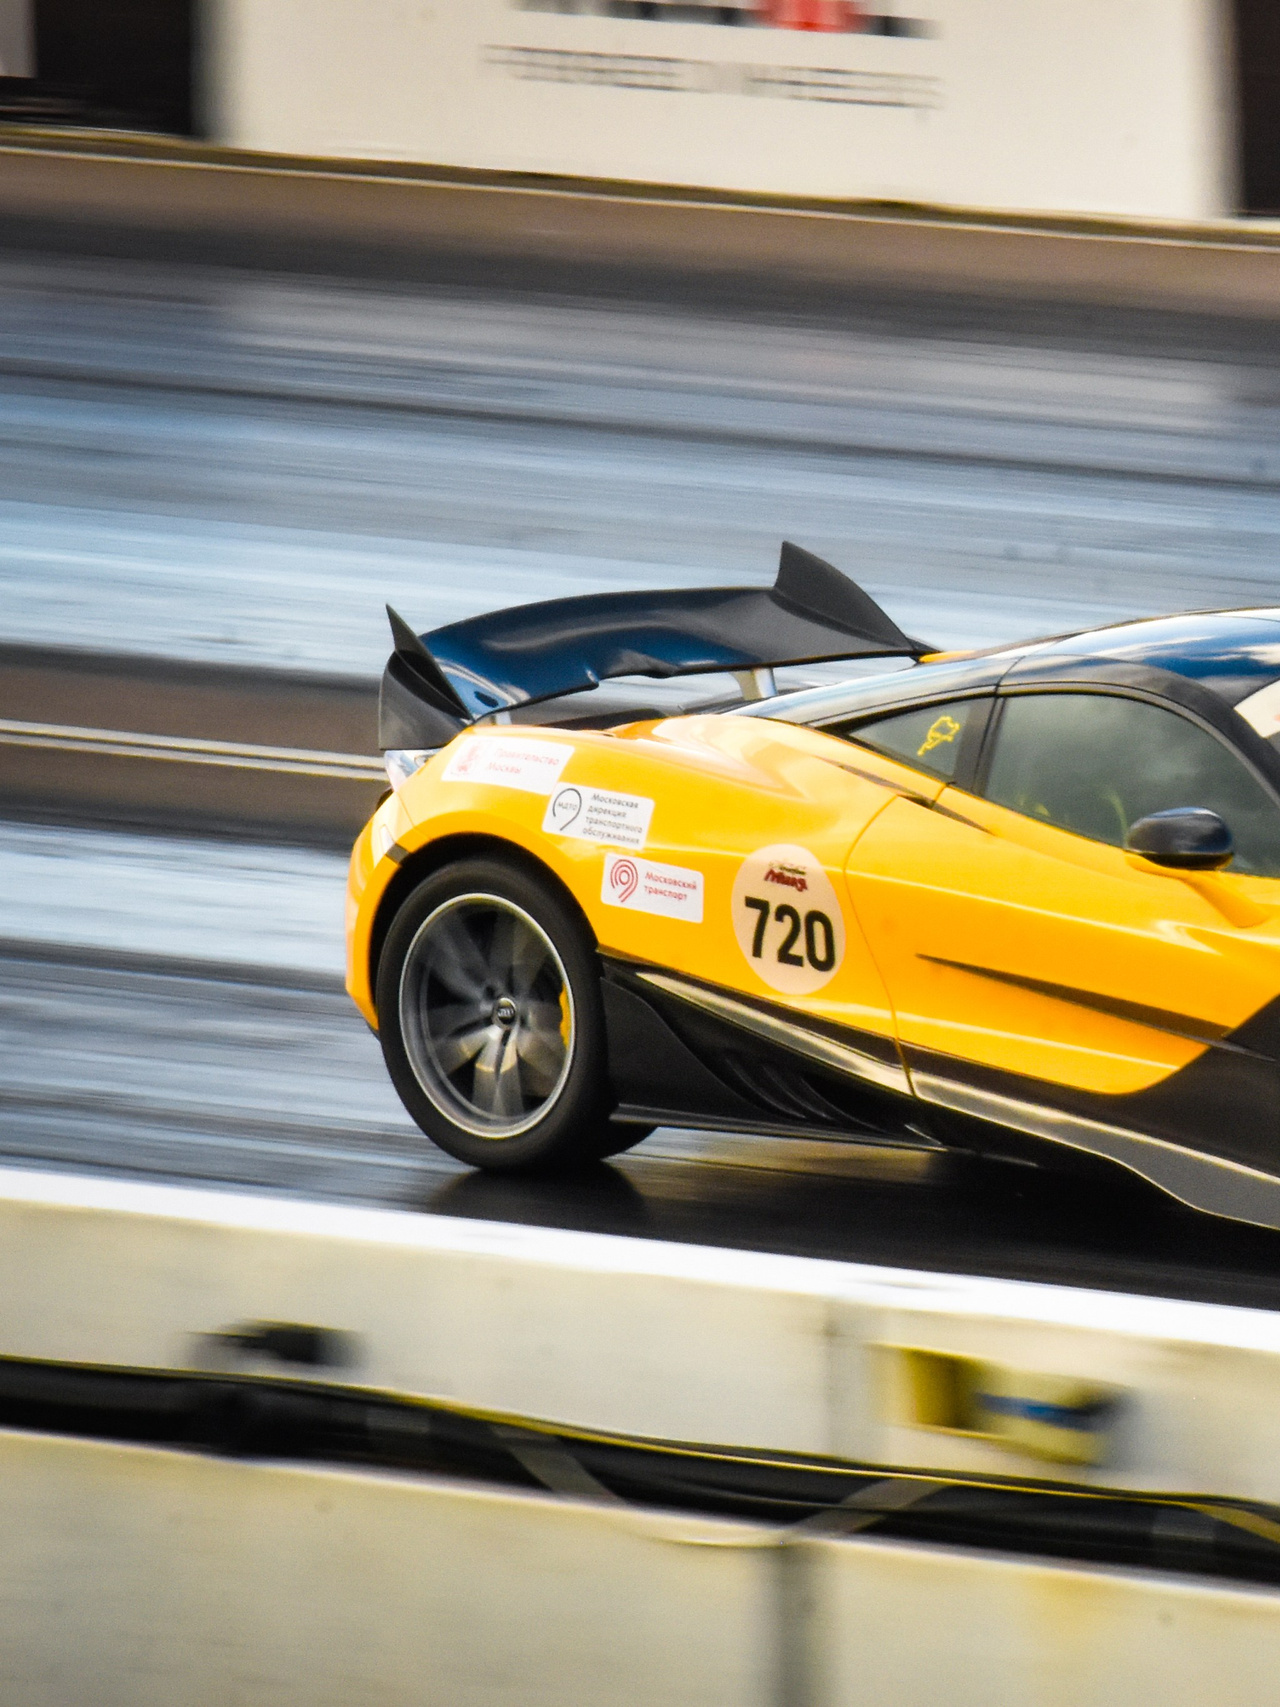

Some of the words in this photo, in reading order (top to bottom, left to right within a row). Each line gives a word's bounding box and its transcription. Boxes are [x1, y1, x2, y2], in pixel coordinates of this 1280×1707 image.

[591, 792, 639, 809] Московская
[587, 805, 628, 818] дирекция
[585, 816, 643, 834] транспортного
[582, 827, 641, 845] обслуживания
[645, 871, 698, 891] Московский
[643, 885, 688, 902] транспорт
[744, 896, 836, 972] 720
